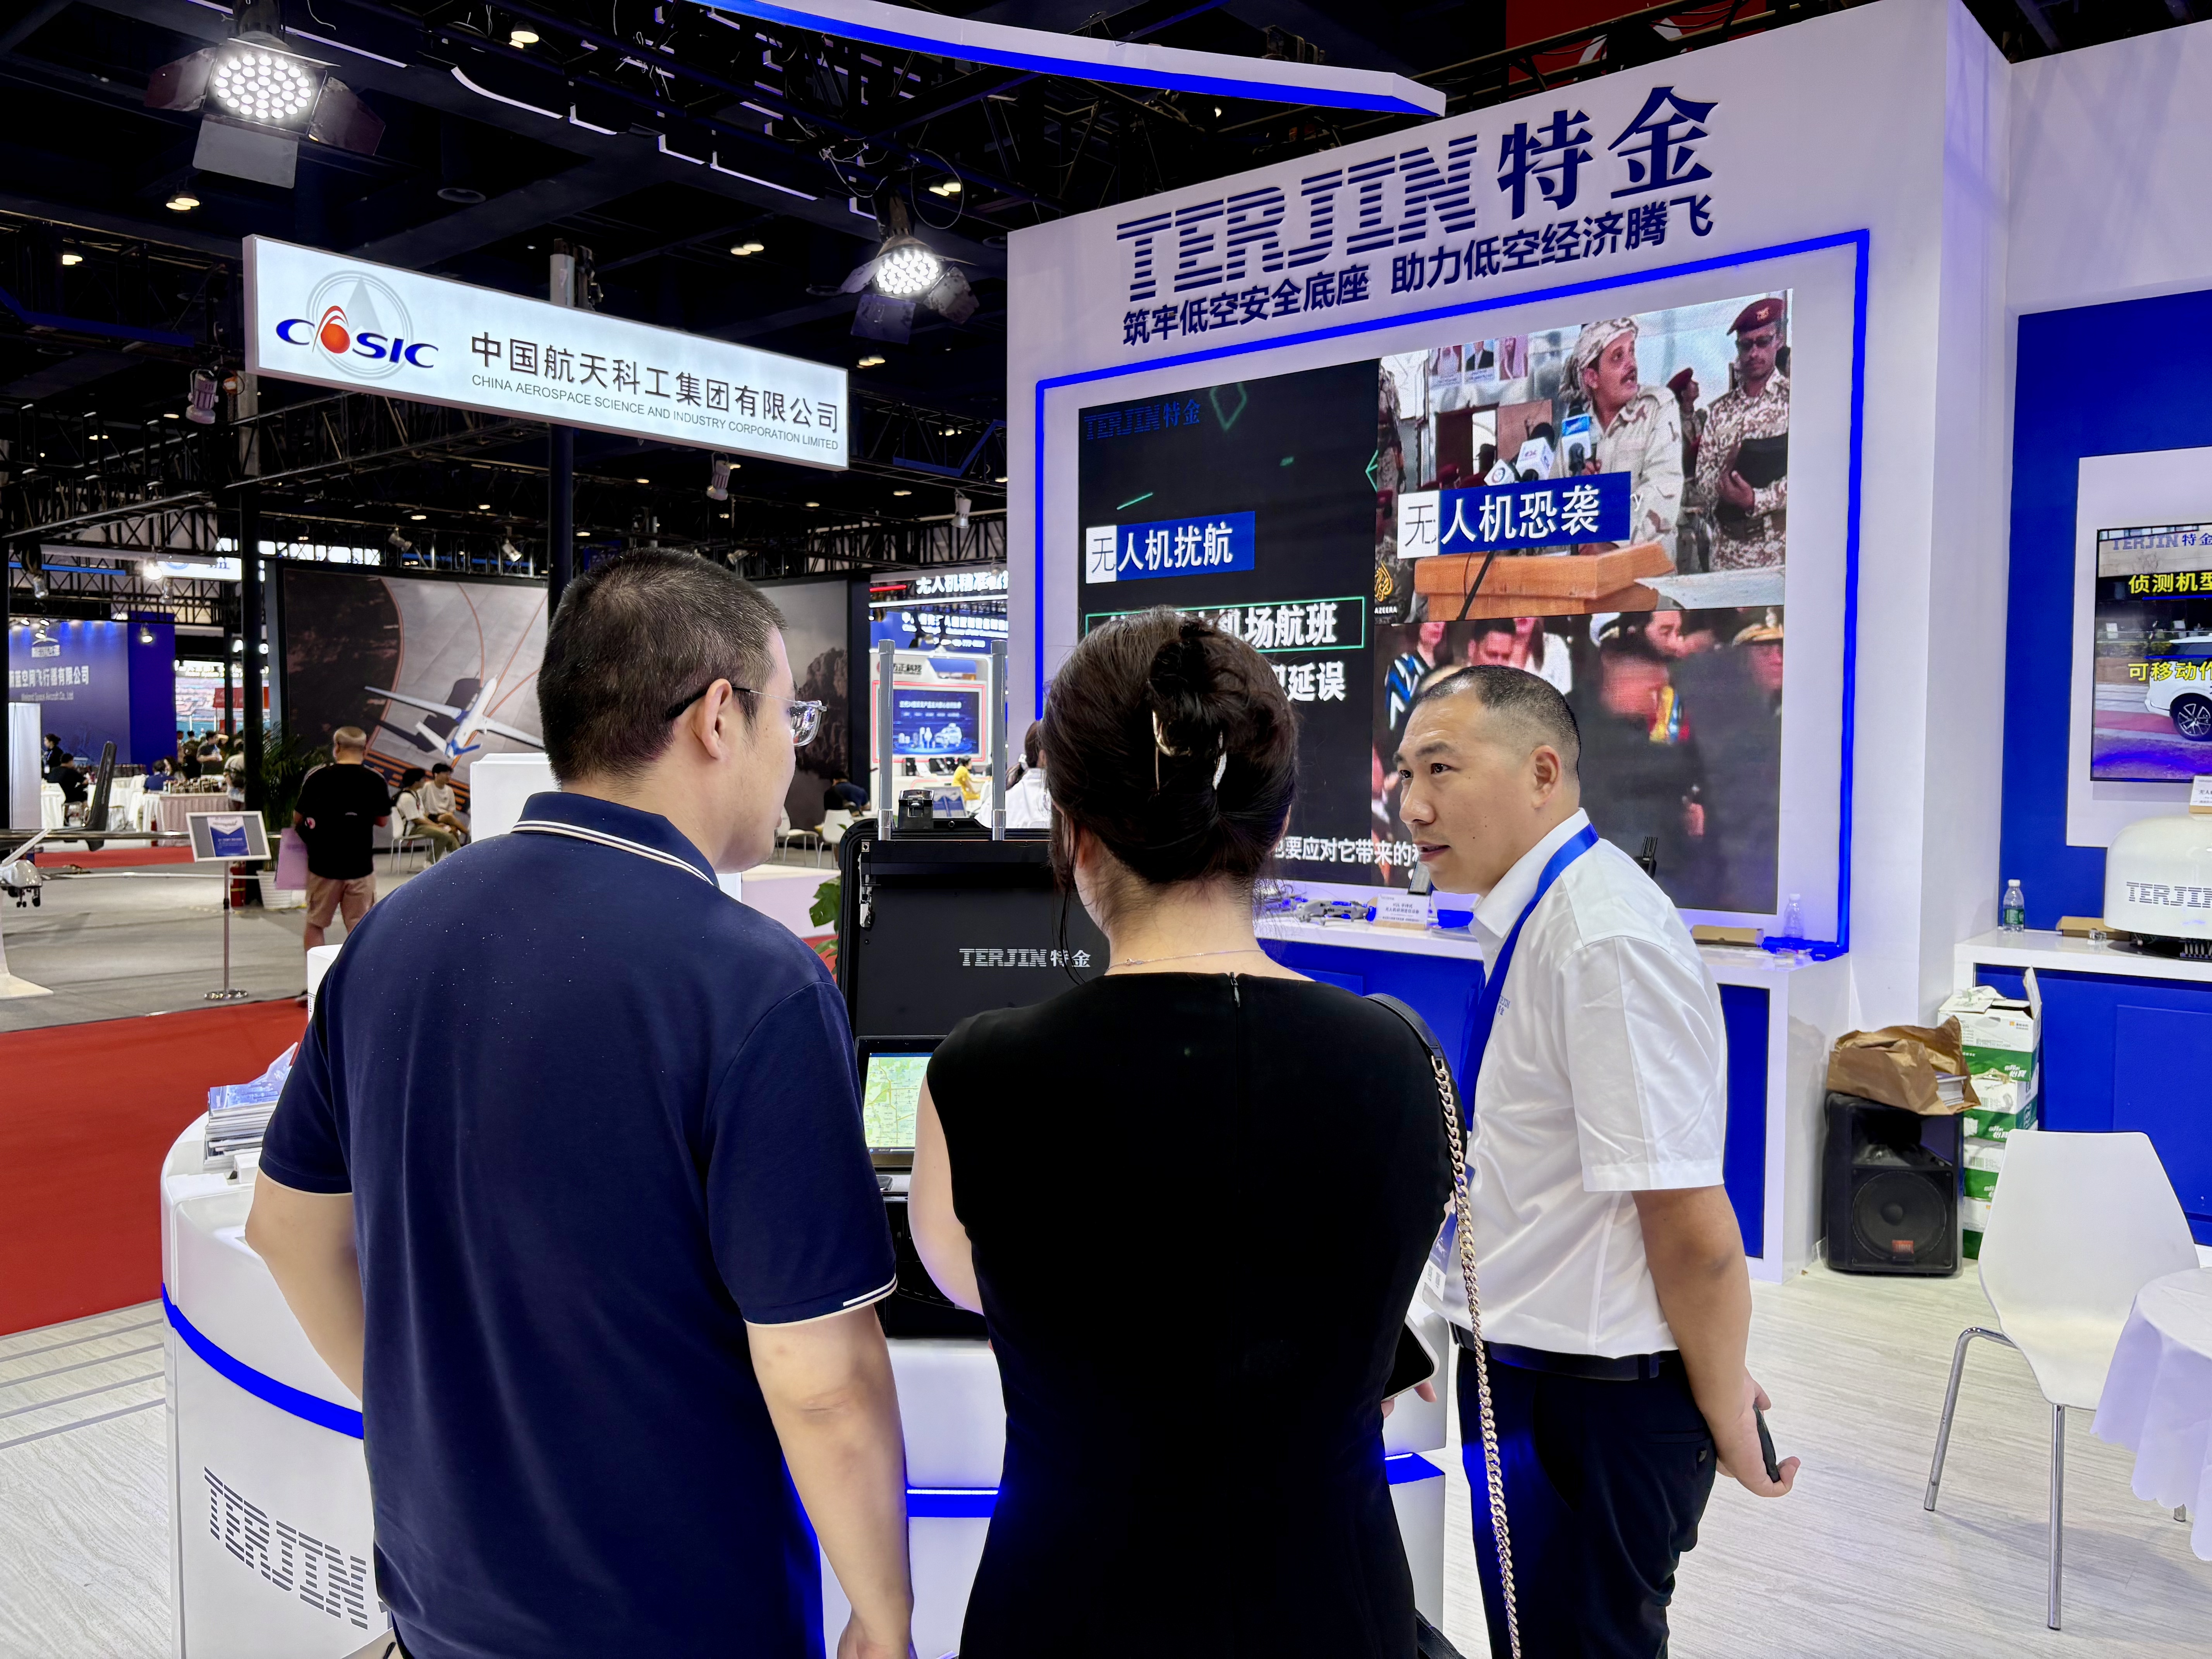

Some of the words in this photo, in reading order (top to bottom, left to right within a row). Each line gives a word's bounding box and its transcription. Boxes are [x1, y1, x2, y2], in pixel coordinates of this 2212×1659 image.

[1117, 134, 1478, 302] TERJIN
[1498, 85, 1719, 220] 特金
[1122, 264, 1372, 347] 筑牢低空安全底座
[1391, 194, 1713, 295] 助力低空经济腾飞
[471, 331, 838, 434] 中国航天科工集团有限公司
[472, 374, 512, 392] CHINA
[515, 382, 591, 405] AEROSPACE
[594, 397, 645, 415] SCIENCE
[647, 406, 670, 419] AND
[673, 410, 726, 429] INDUSTRY
[729, 421, 800, 443] CORPORATION
[802, 436, 838, 450] LIMITED
[1084, 404, 1160, 440] TERJIN
[1163, 398, 1200, 428] 特金
[1091, 521, 1233, 574] 无人机扰航
[1404, 484, 1600, 548] 无人机恐袭
[959, 948, 1047, 967] TERJIN
[1051, 949, 1091, 967] 特金
[204, 1466, 368, 1630] TERJIN
